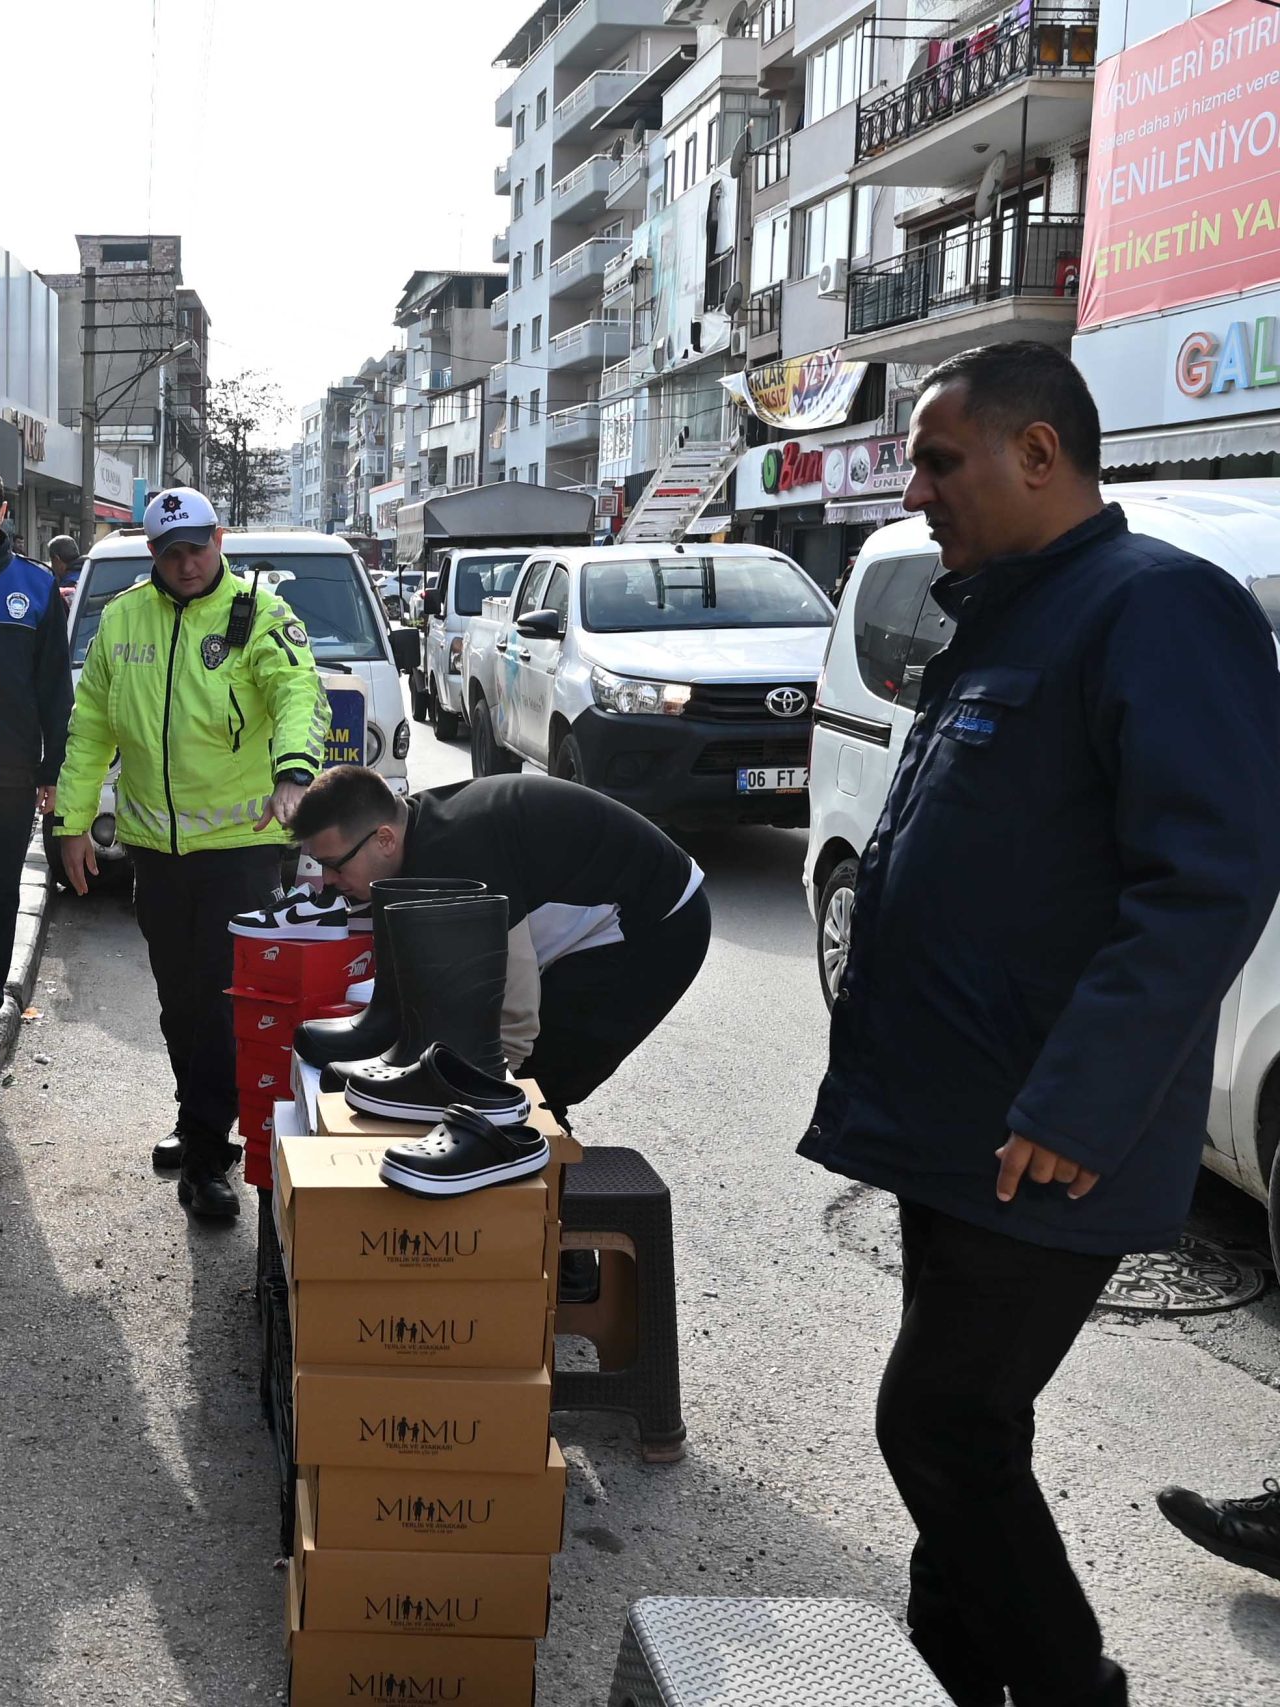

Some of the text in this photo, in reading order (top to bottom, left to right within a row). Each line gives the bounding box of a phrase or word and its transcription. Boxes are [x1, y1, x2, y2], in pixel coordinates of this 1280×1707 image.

[1100, 9, 1280, 118] ÜRÜNLERİ BİTİRİ
[1139, 115, 1170, 137] daha
[1173, 106, 1189, 126] iyi
[1192, 84, 1242, 115] hizmet
[1246, 71, 1280, 92] vere
[1097, 110, 1280, 210] YENİLENİYO
[1095, 198, 1280, 279] ETİKETİN YA
[601, 499, 614, 513] E
[748, 770, 766, 788] 06
[777, 770, 796, 787] FT
